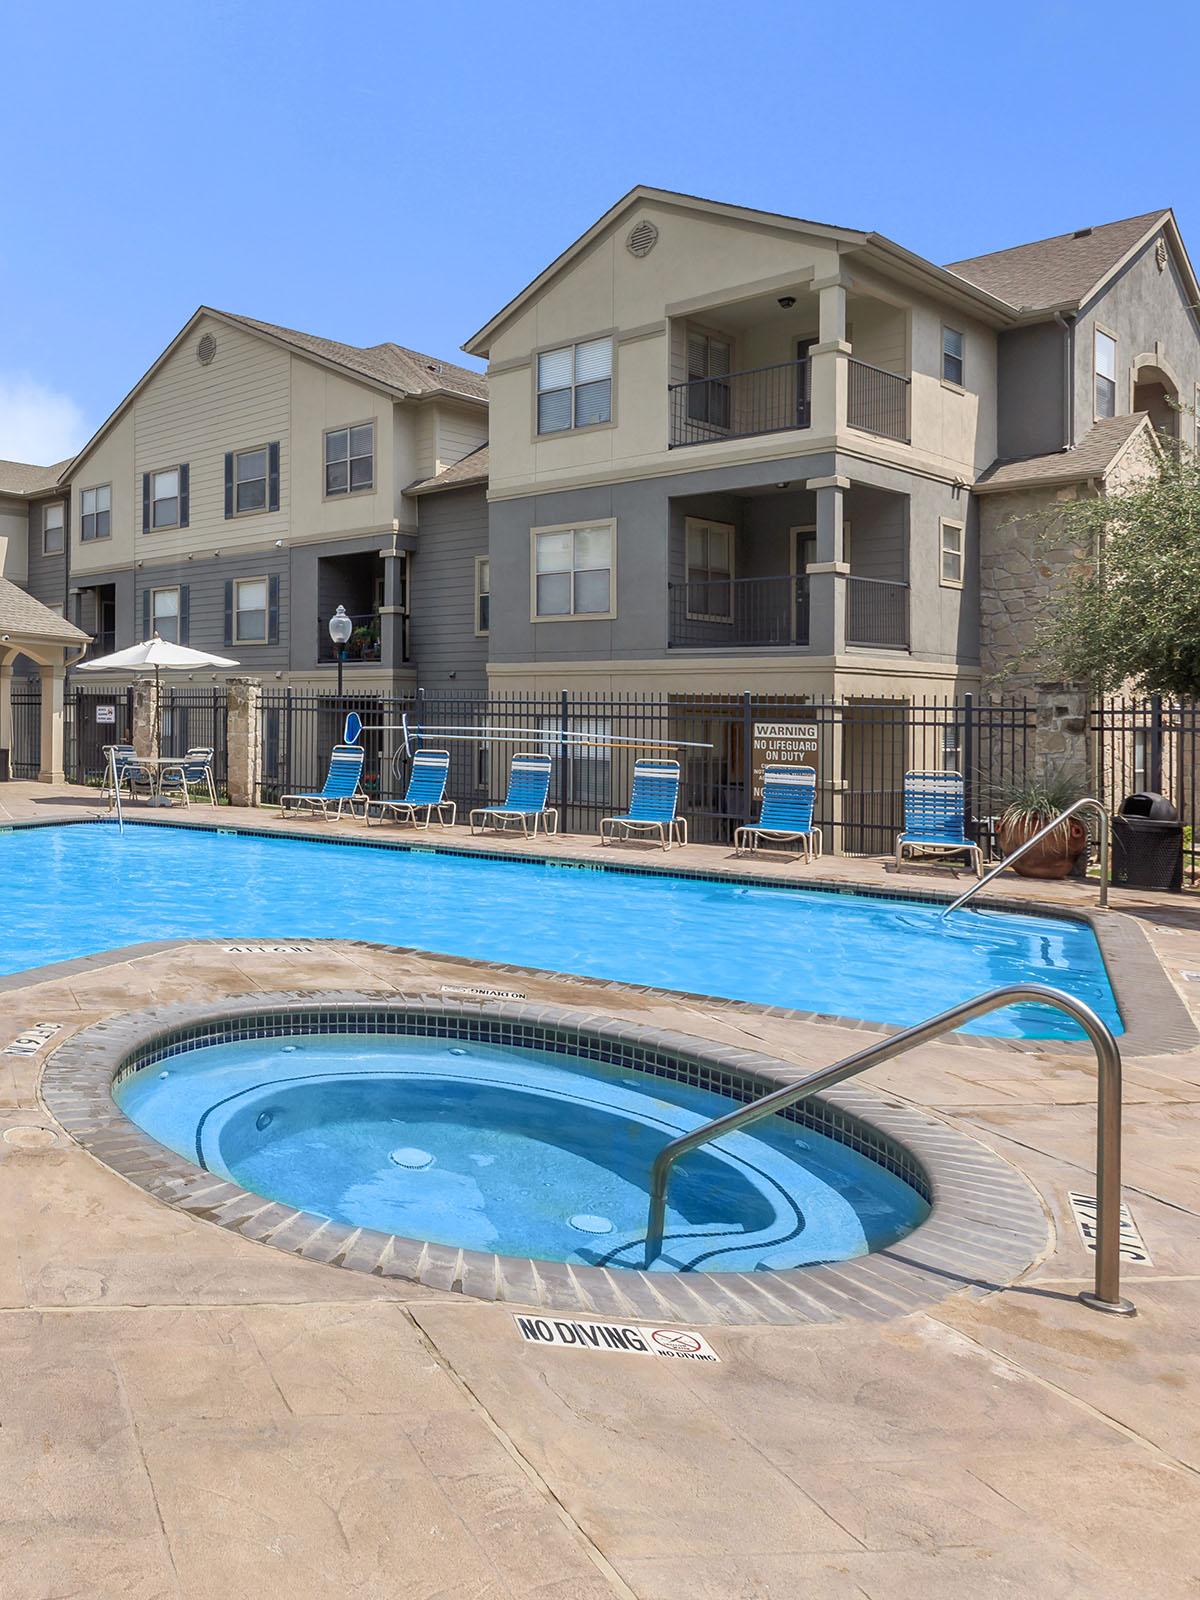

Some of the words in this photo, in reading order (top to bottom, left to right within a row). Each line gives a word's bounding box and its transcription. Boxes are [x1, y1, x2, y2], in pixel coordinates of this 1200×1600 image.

[756, 726, 815, 737] WARNING
[753, 740, 767, 749] NO
[769, 741, 817, 751] LIFEGUARD
[765, 751, 779, 760] ON
[781, 752, 805, 761] DUTY
[470, 988, 509, 997] DIVING
[517, 1317, 555, 1342] NO
[553, 1321, 650, 1352] DIVING
[657, 1349, 675, 1357] NO
[676, 1351, 717, 1362] DIVING
